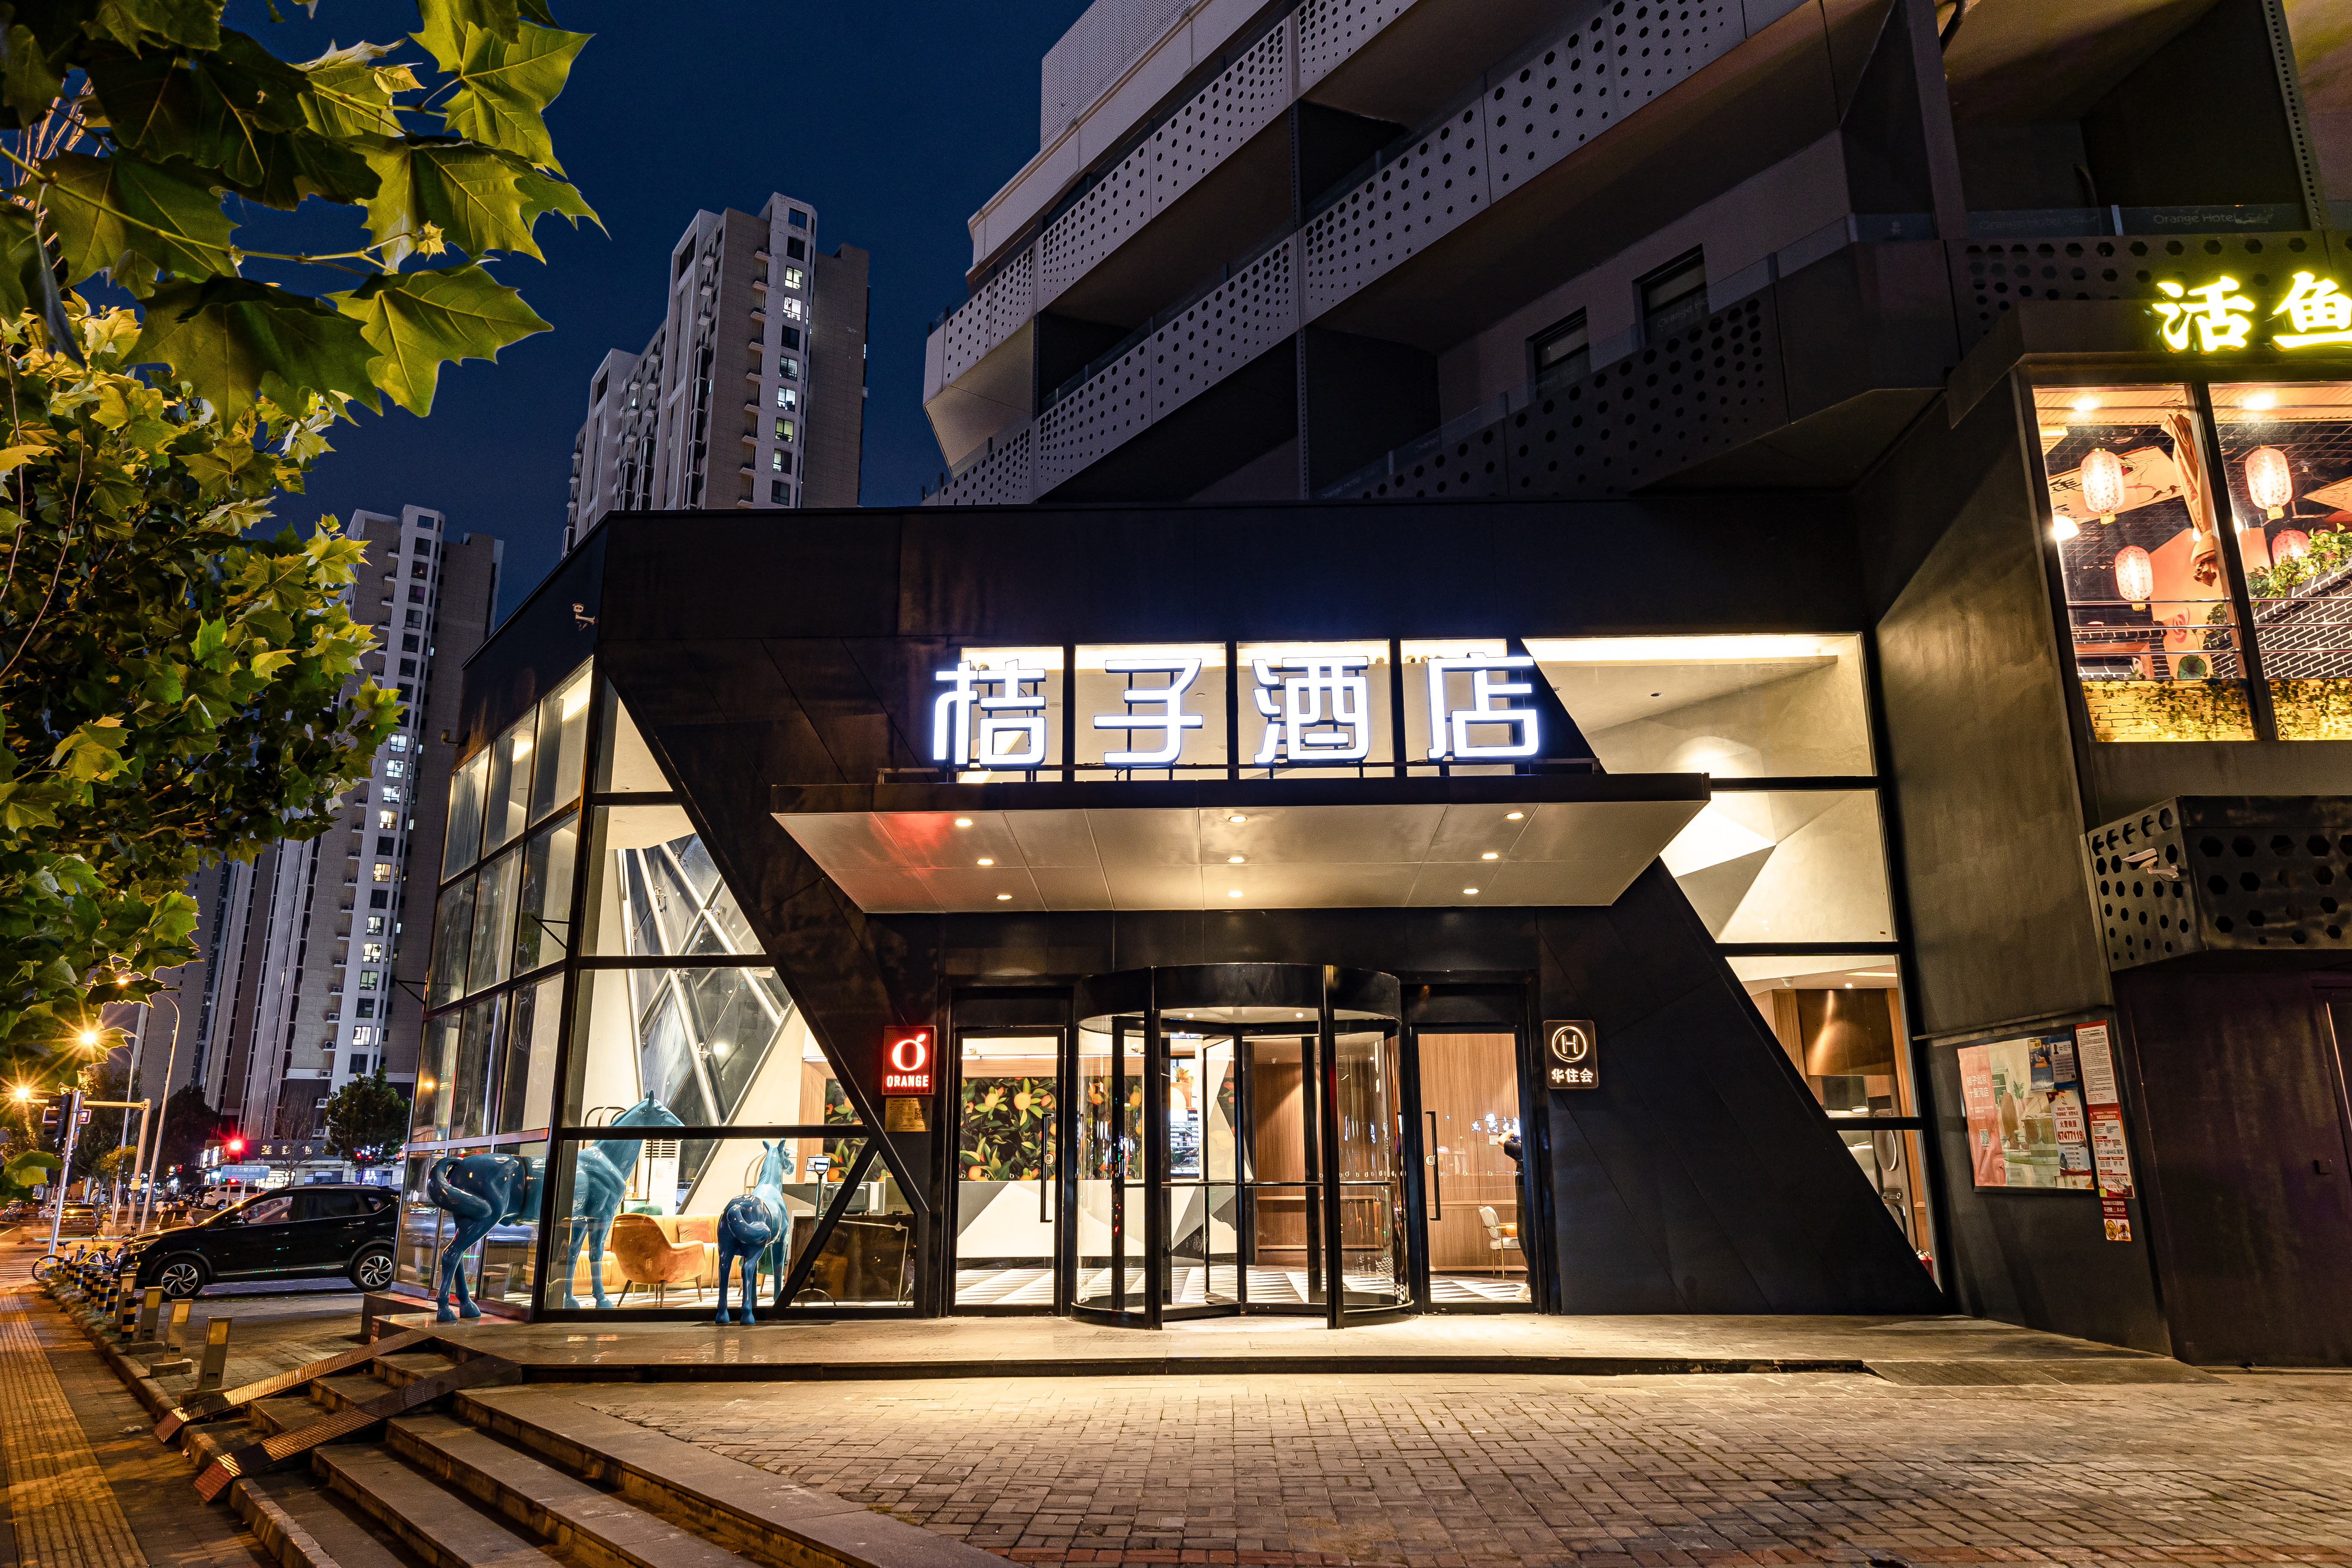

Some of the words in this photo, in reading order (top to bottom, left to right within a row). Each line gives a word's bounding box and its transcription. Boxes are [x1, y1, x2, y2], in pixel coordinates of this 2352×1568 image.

[2153, 214, 2199, 225] Orange
[2202, 213, 2236, 223] Hotel
[2152, 271, 2352, 353] 活鱼
[933, 652, 1540, 769] 桔子酒店
[886, 1075, 929, 1087] ORANGE
[1551, 1068, 1593, 1083] 华住会
